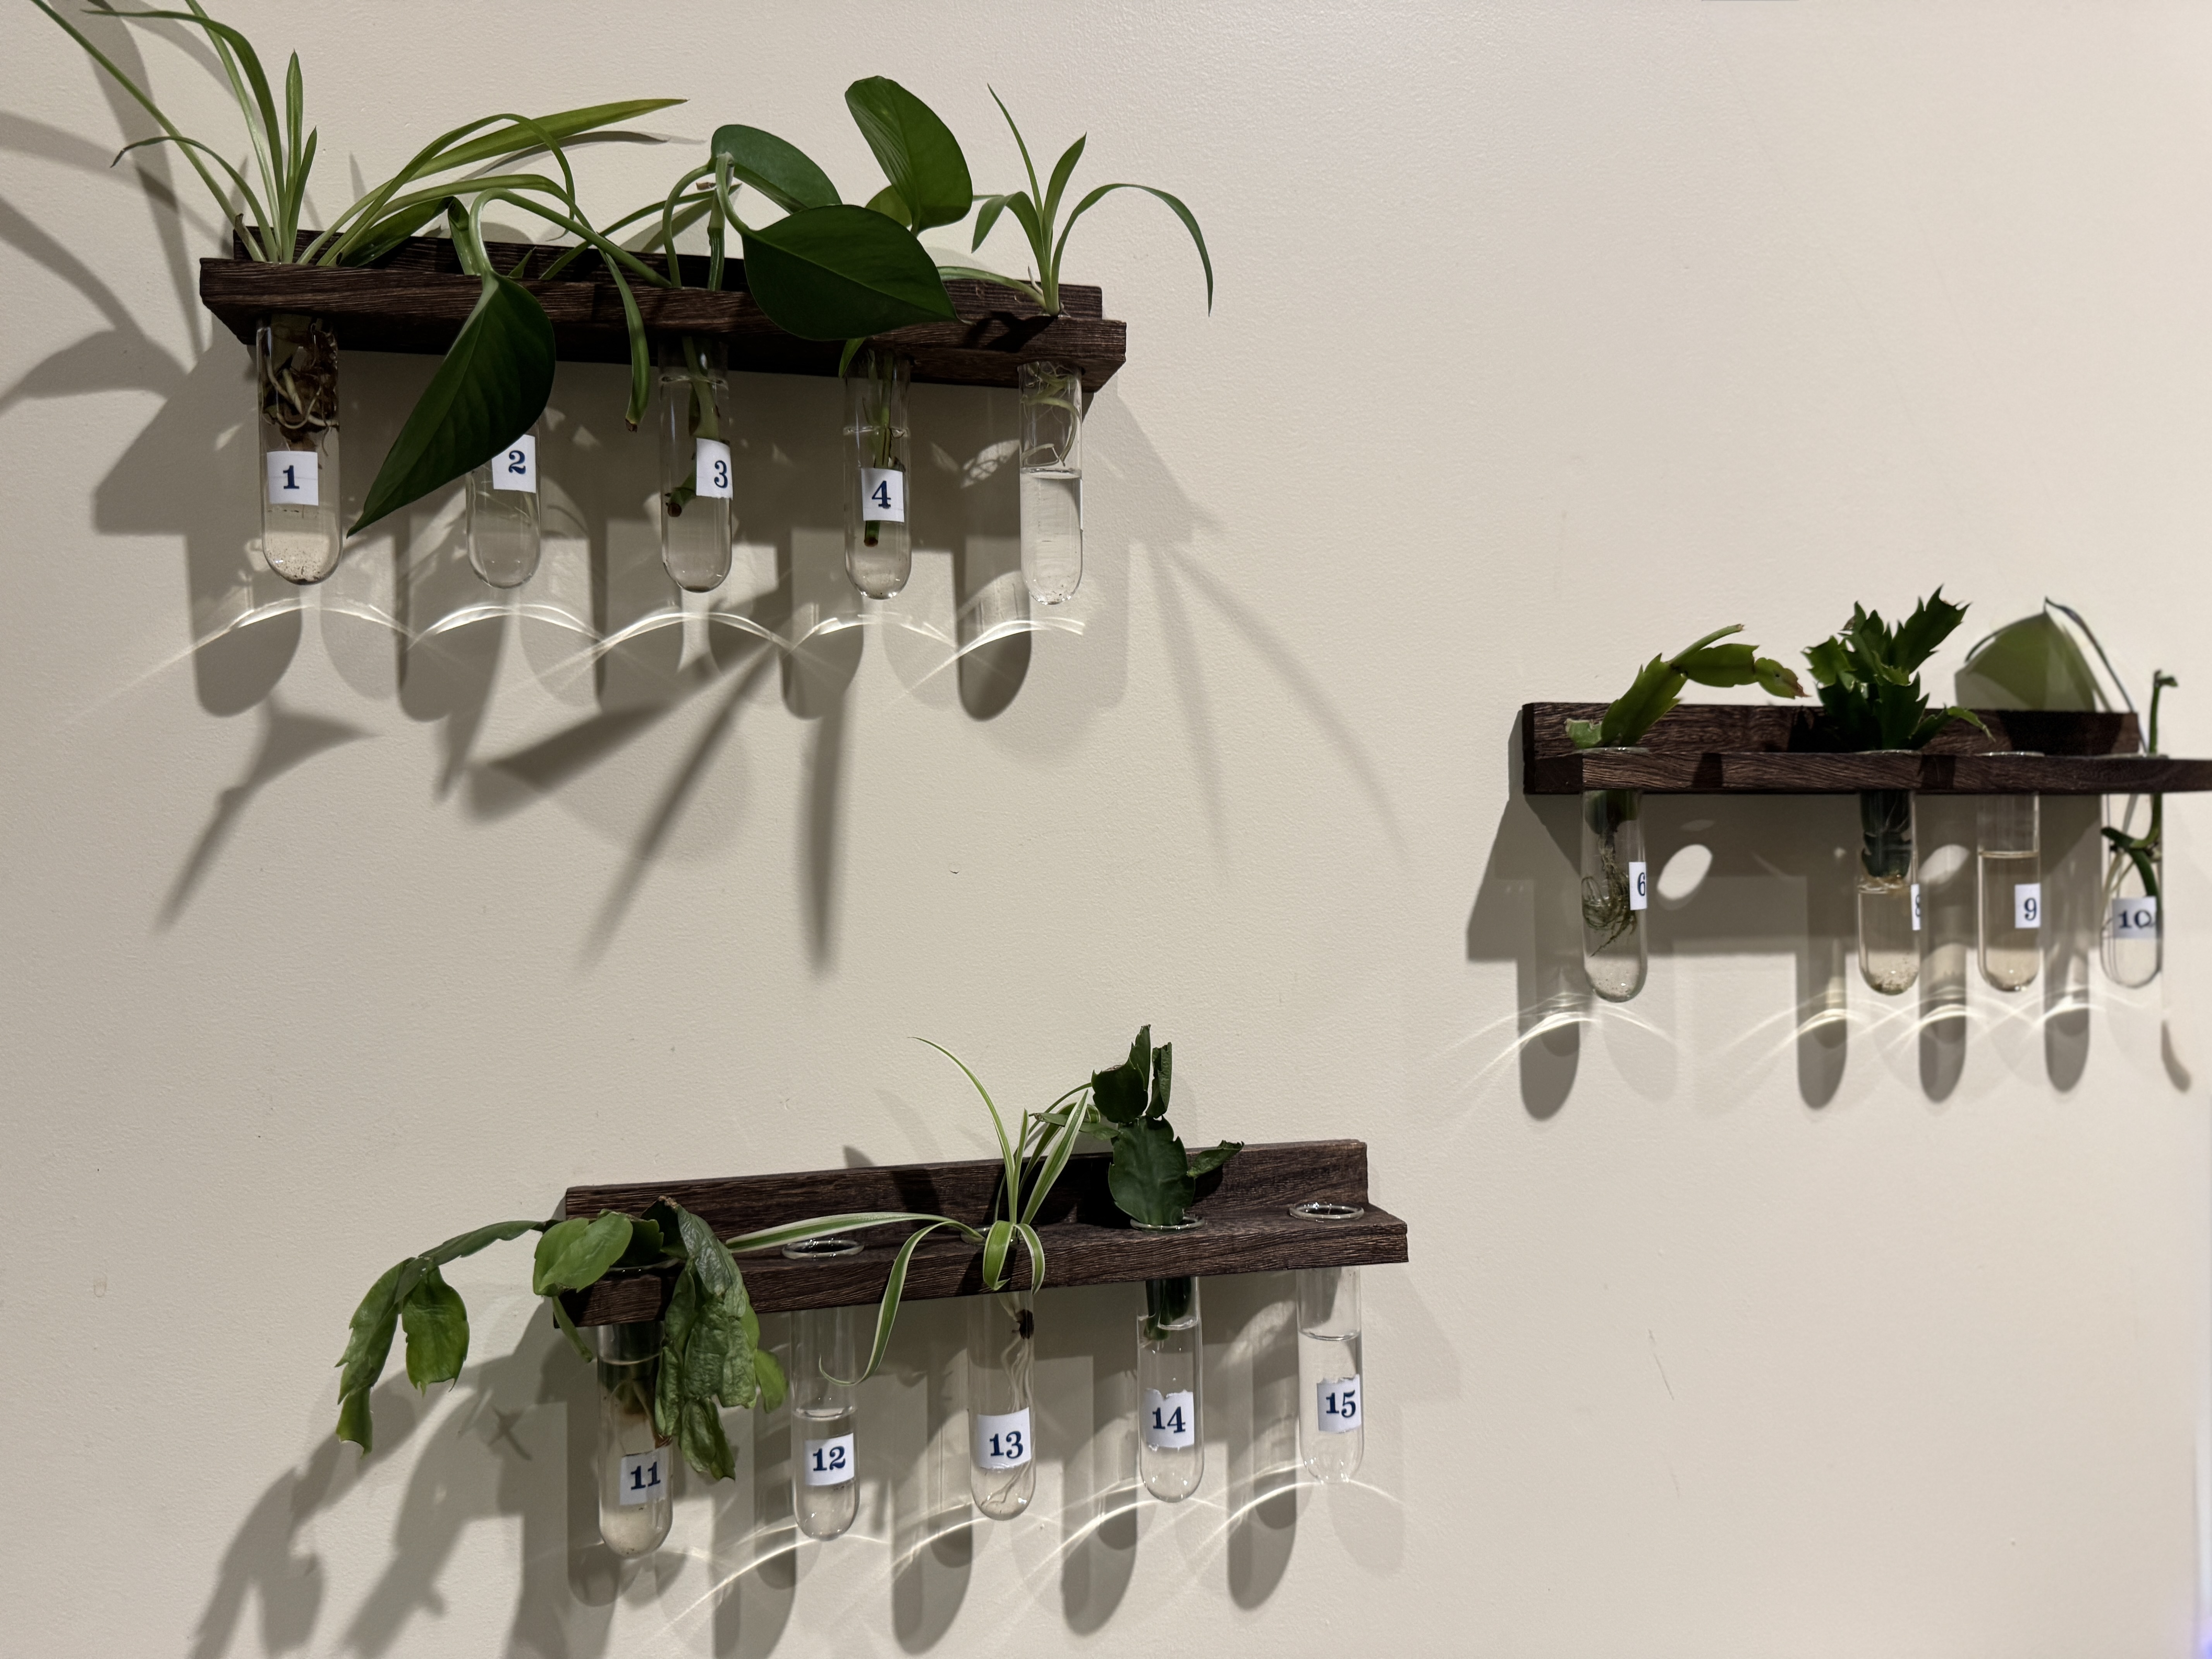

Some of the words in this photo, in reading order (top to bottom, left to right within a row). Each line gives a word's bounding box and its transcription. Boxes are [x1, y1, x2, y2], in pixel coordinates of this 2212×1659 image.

[508, 450, 526, 474] 2
[714, 460, 728, 488] 3
[283, 465, 300, 489] 1
[872, 480, 891, 508] 4
[1637, 872, 1646, 896] 6
[2025, 898, 2037, 921] 9
[2118, 909, 2152, 929] 10
[1326, 1390, 1356, 1418] 15
[1152, 1407, 1185, 1433] 14
[990, 1431, 1023, 1458] 13
[812, 1446, 845, 1471] 12
[630, 1462, 661, 1490] 11
